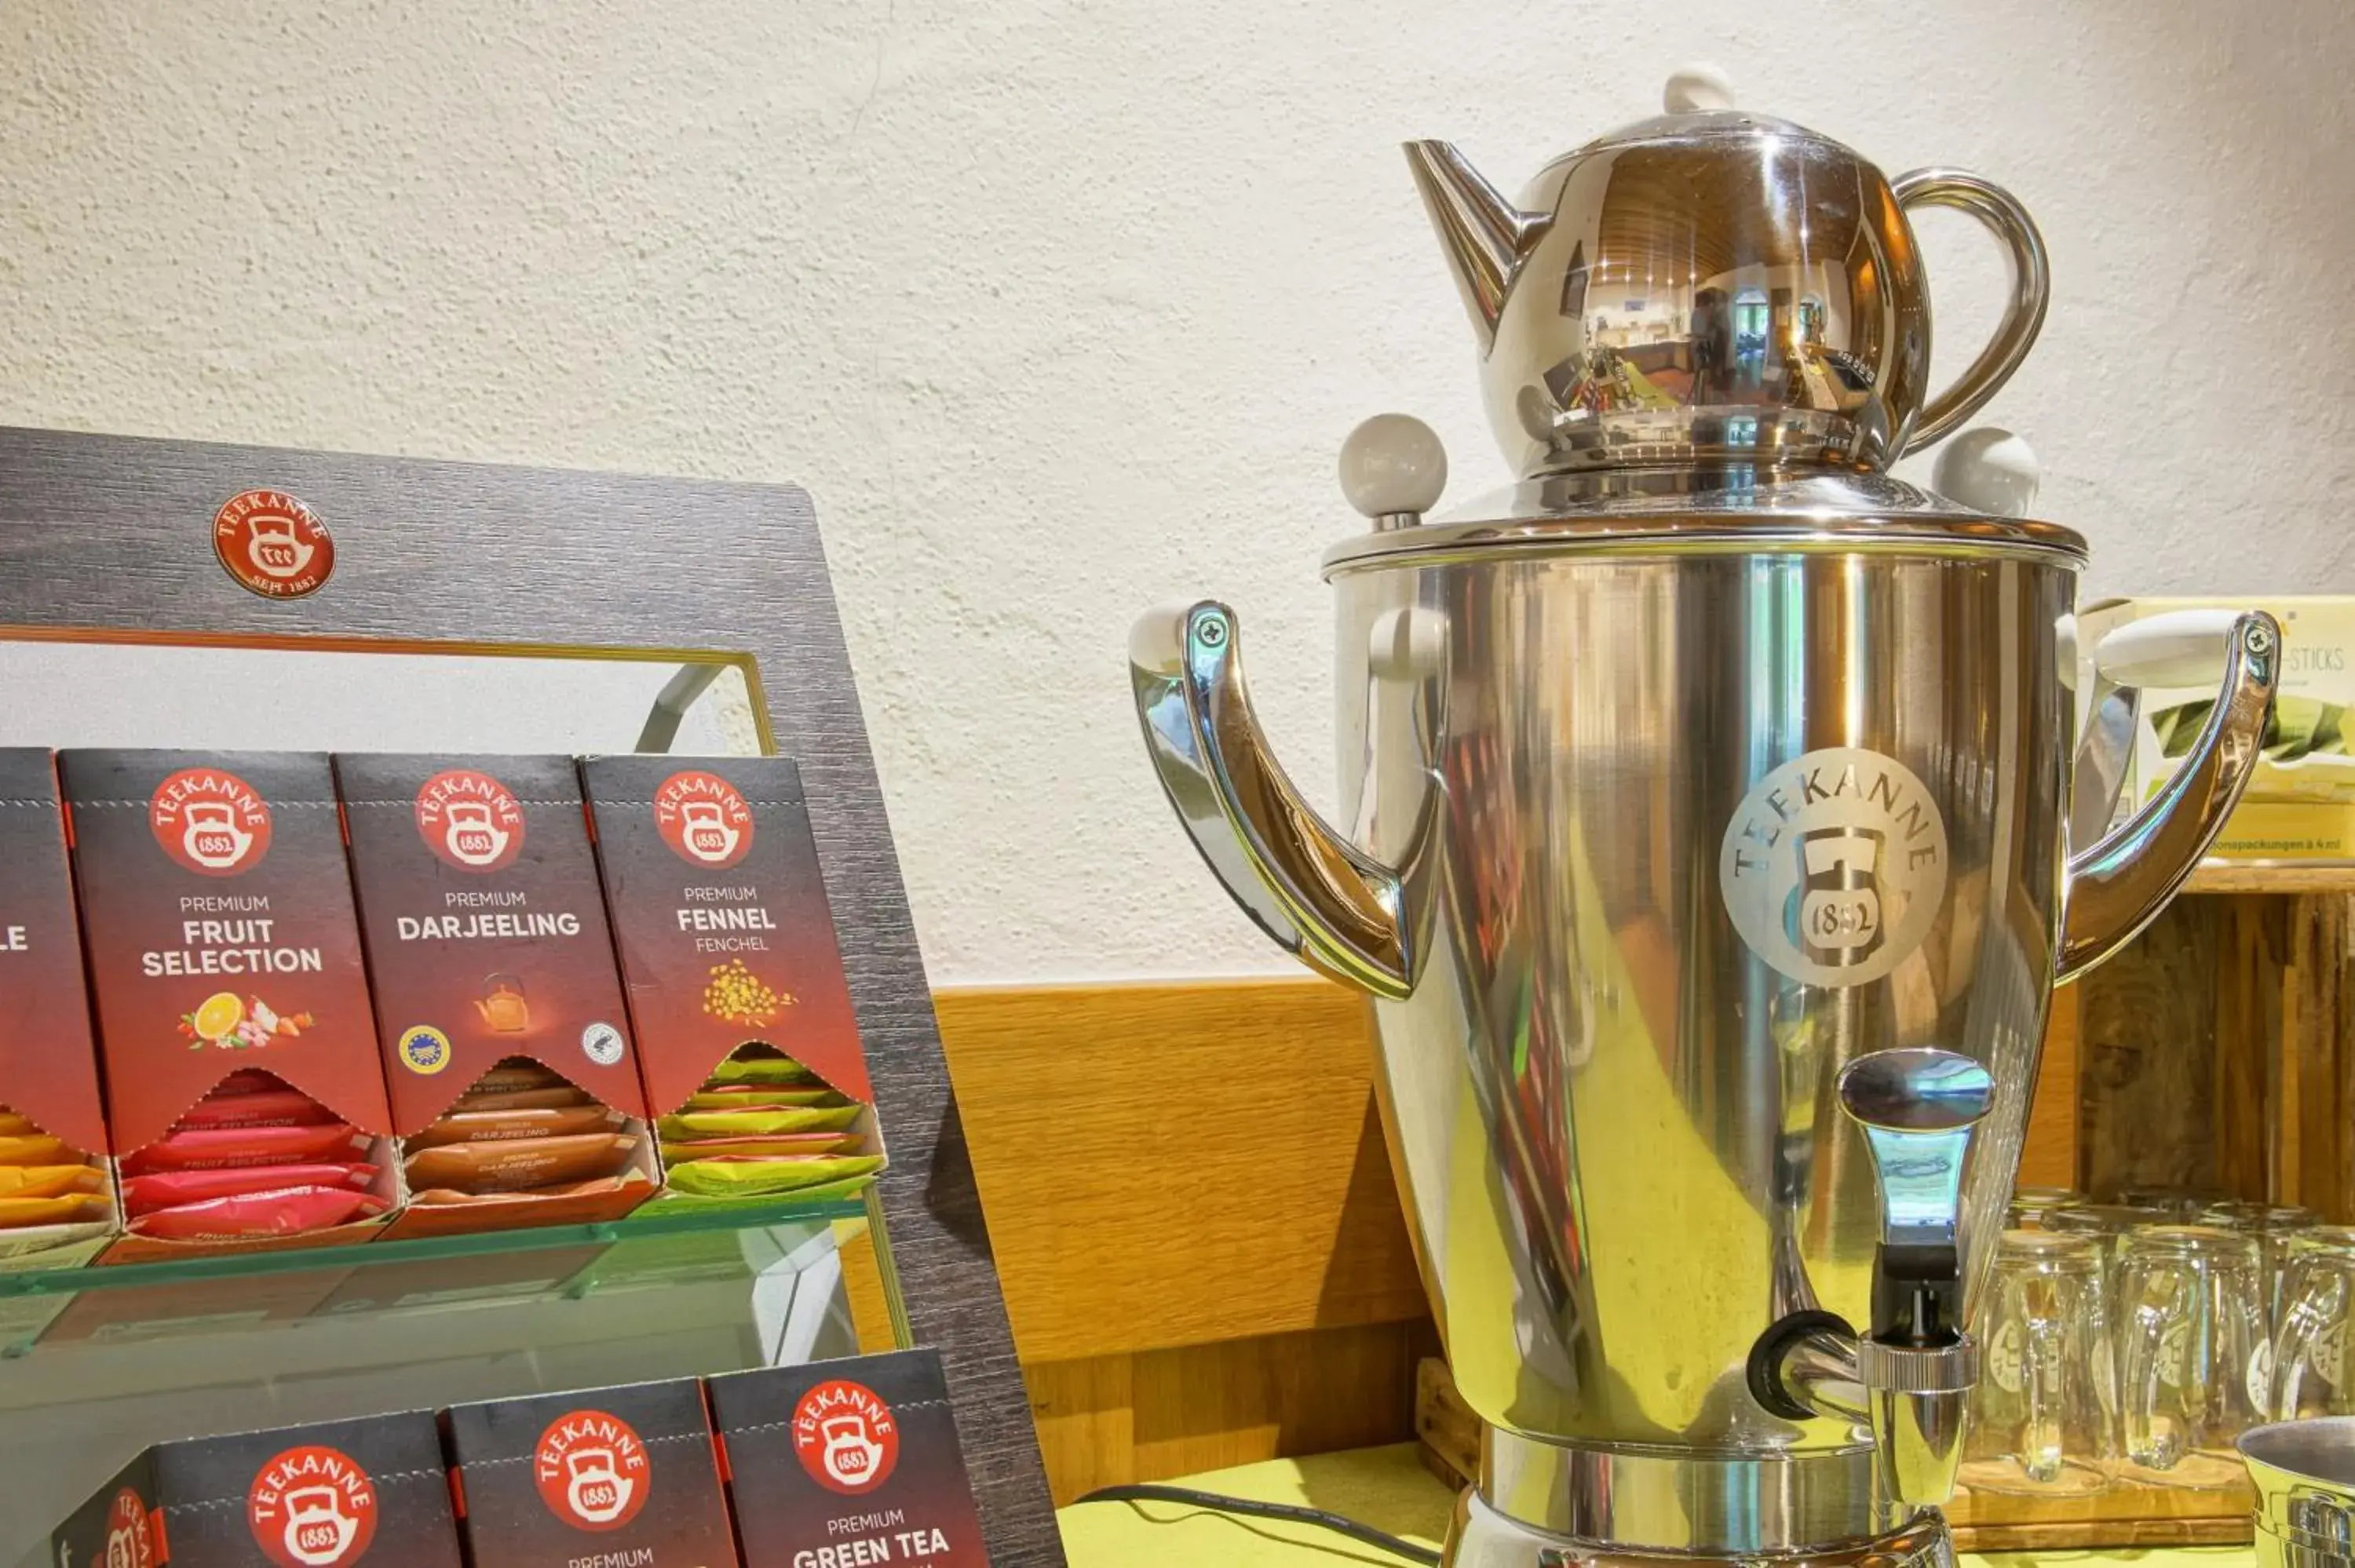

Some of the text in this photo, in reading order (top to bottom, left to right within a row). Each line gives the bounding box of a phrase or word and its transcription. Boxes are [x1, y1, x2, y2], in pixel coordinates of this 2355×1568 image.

[217, 494, 328, 539] TEEKANNE
[156, 775, 265, 826] TEEKANNE
[421, 777, 520, 826] TEEKANNE
[659, 778, 748, 824] TEEKANNE
[1735, 763, 1937, 878] TEEKANNE
[199, 836, 233, 852] 1882
[180, 895, 269, 912] PREMIUM
[445, 891, 526, 907] PREMIUM
[684, 886, 758, 902] PREMIUM
[183, 919, 273, 944] FRUIT
[397, 913, 581, 941] DARJEELING
[677, 908, 776, 932] FENNEL
[1812, 902, 1873, 935] 1882
[696, 936, 769, 953] FENCHEL
[142, 947, 323, 977] SELECTION
[798, 1387, 893, 1448] TEEKANNE
[539, 1418, 644, 1482] TEEKANNE
[836, 1449, 867, 1470] 1882
[254, 1454, 371, 1524] TEEKANNE
[582, 1485, 616, 1506] 1882
[119, 1495, 151, 1568] TEEKA
[827, 1508, 905, 1536] PREMIUM
[300, 1526, 338, 1548] 1882
[793, 1527, 951, 1568] GREEN TEA
[568, 1548, 654, 1568] PREMIUM
